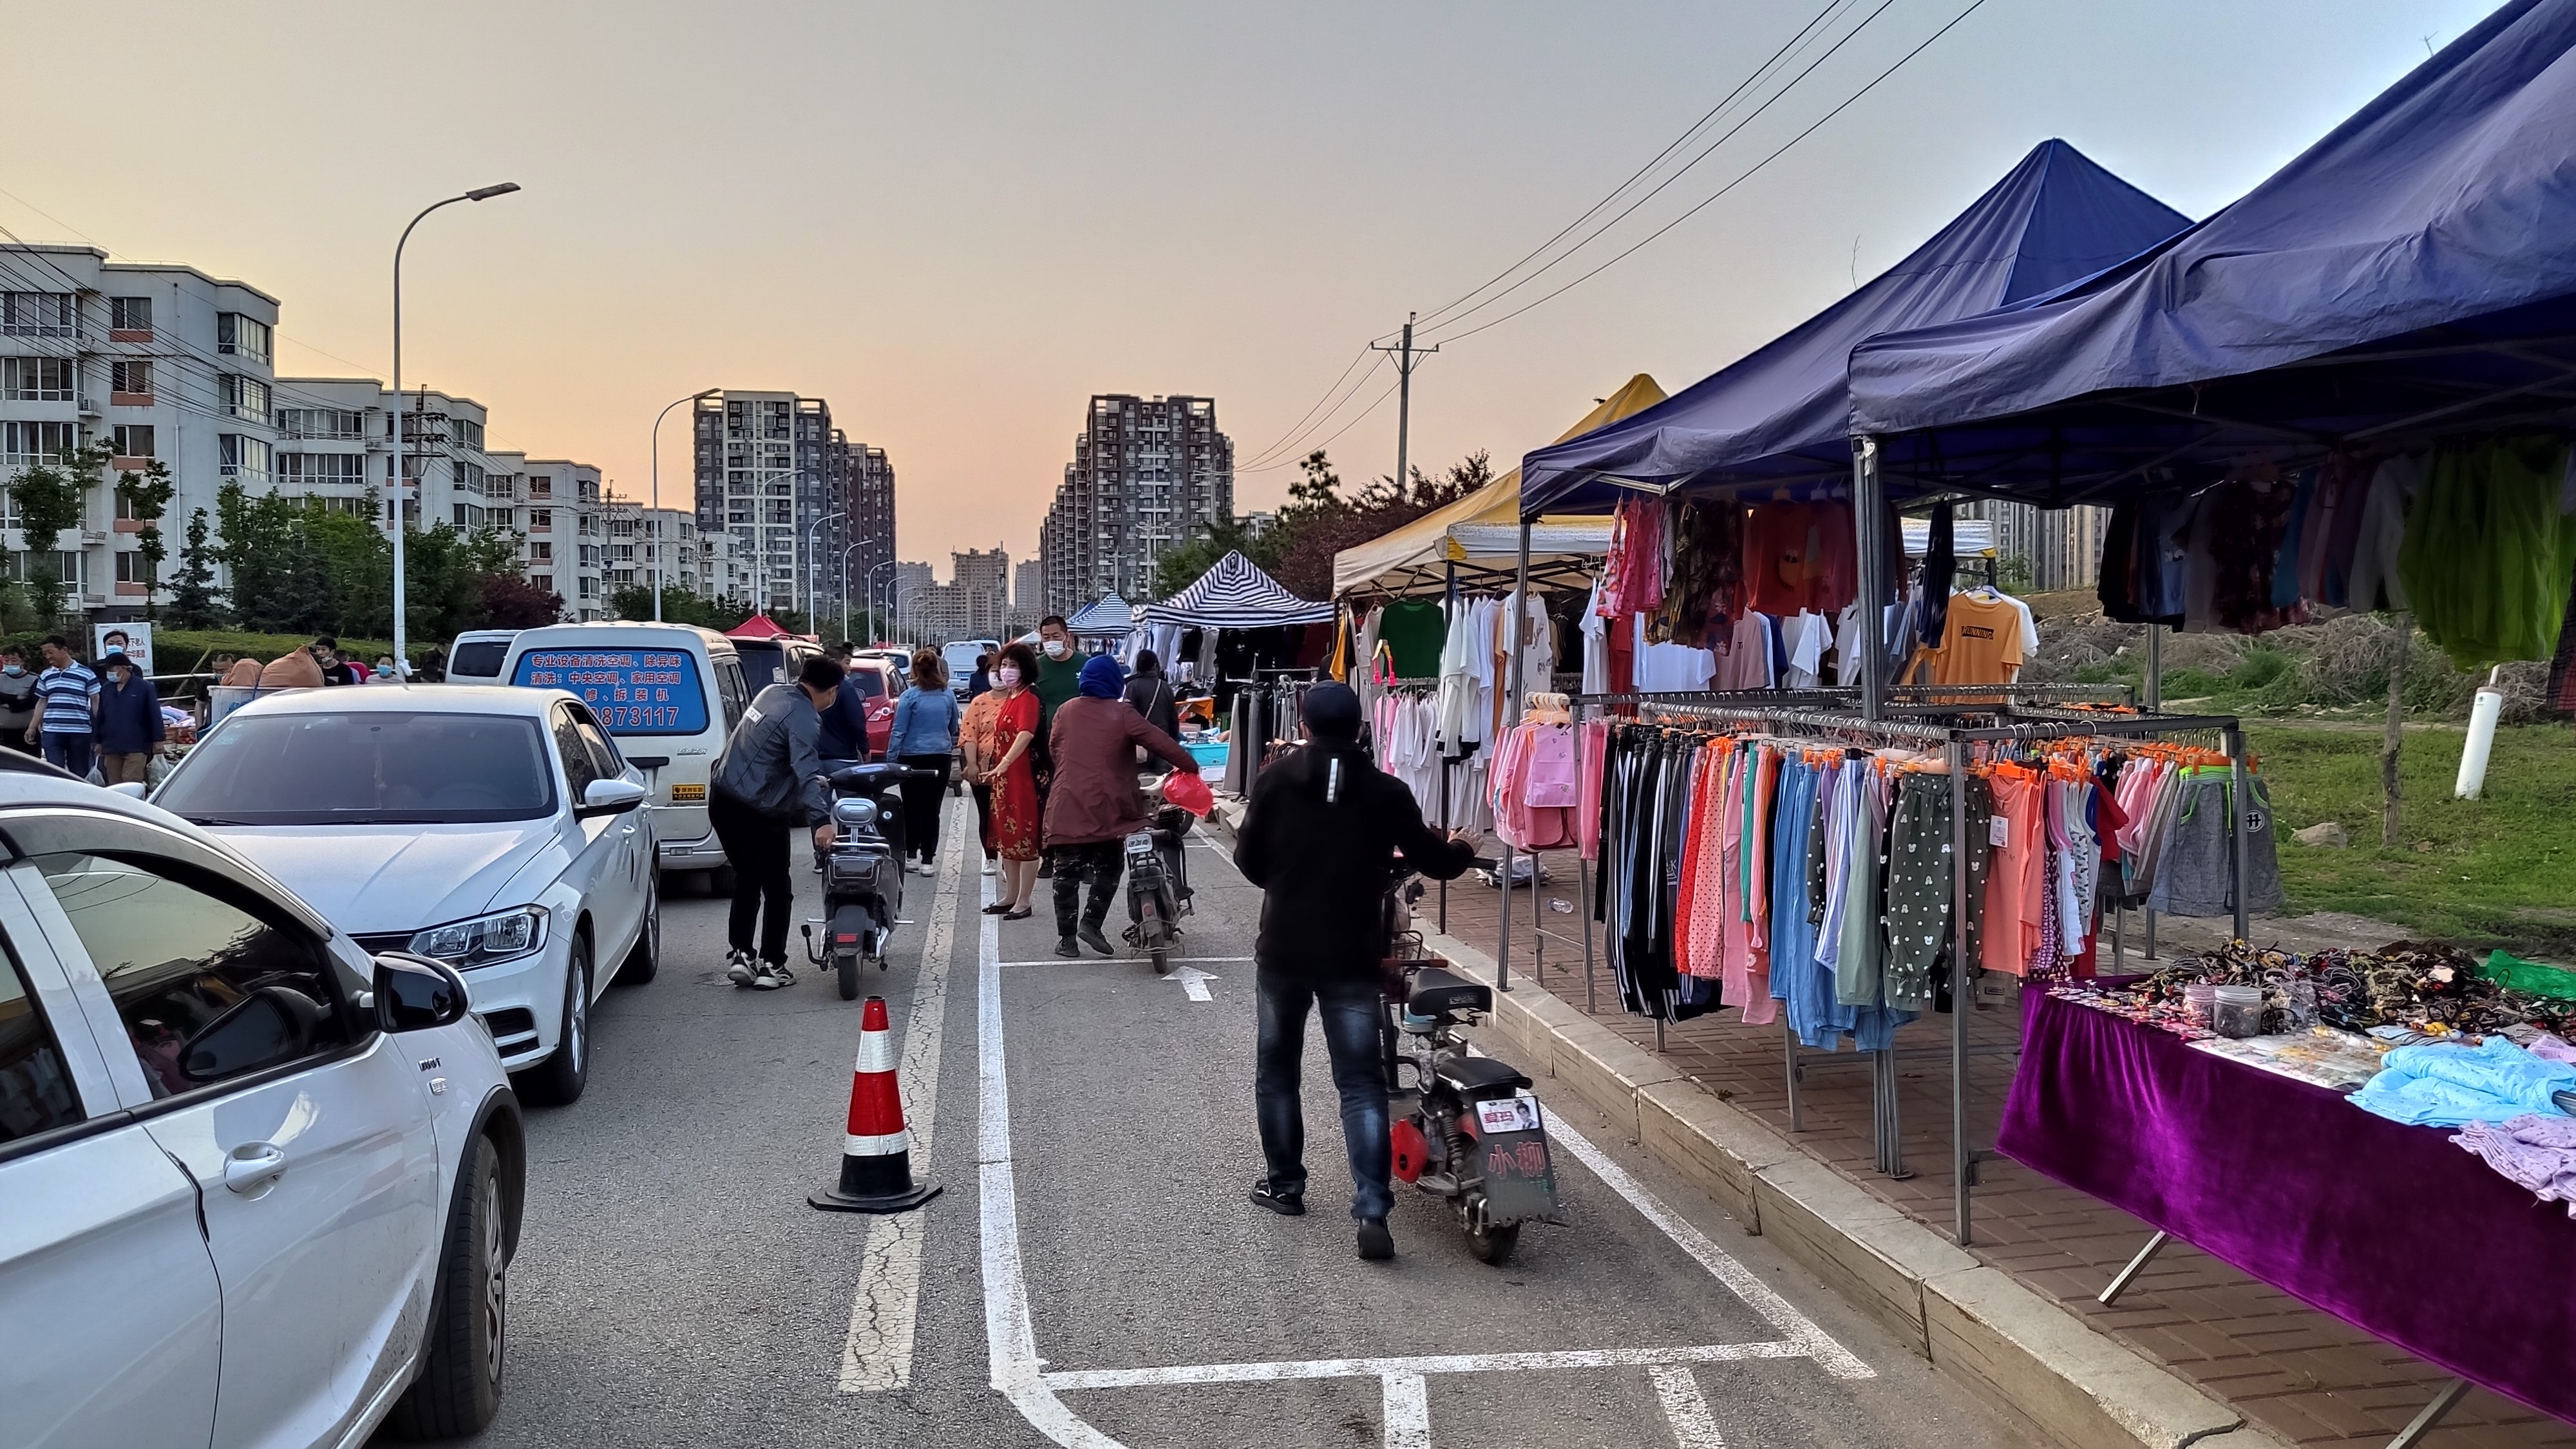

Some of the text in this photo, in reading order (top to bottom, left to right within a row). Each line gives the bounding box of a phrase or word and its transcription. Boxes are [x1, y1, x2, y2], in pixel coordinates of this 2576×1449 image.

[532, 654, 681, 667] 专业设备清洗空调、除异味
